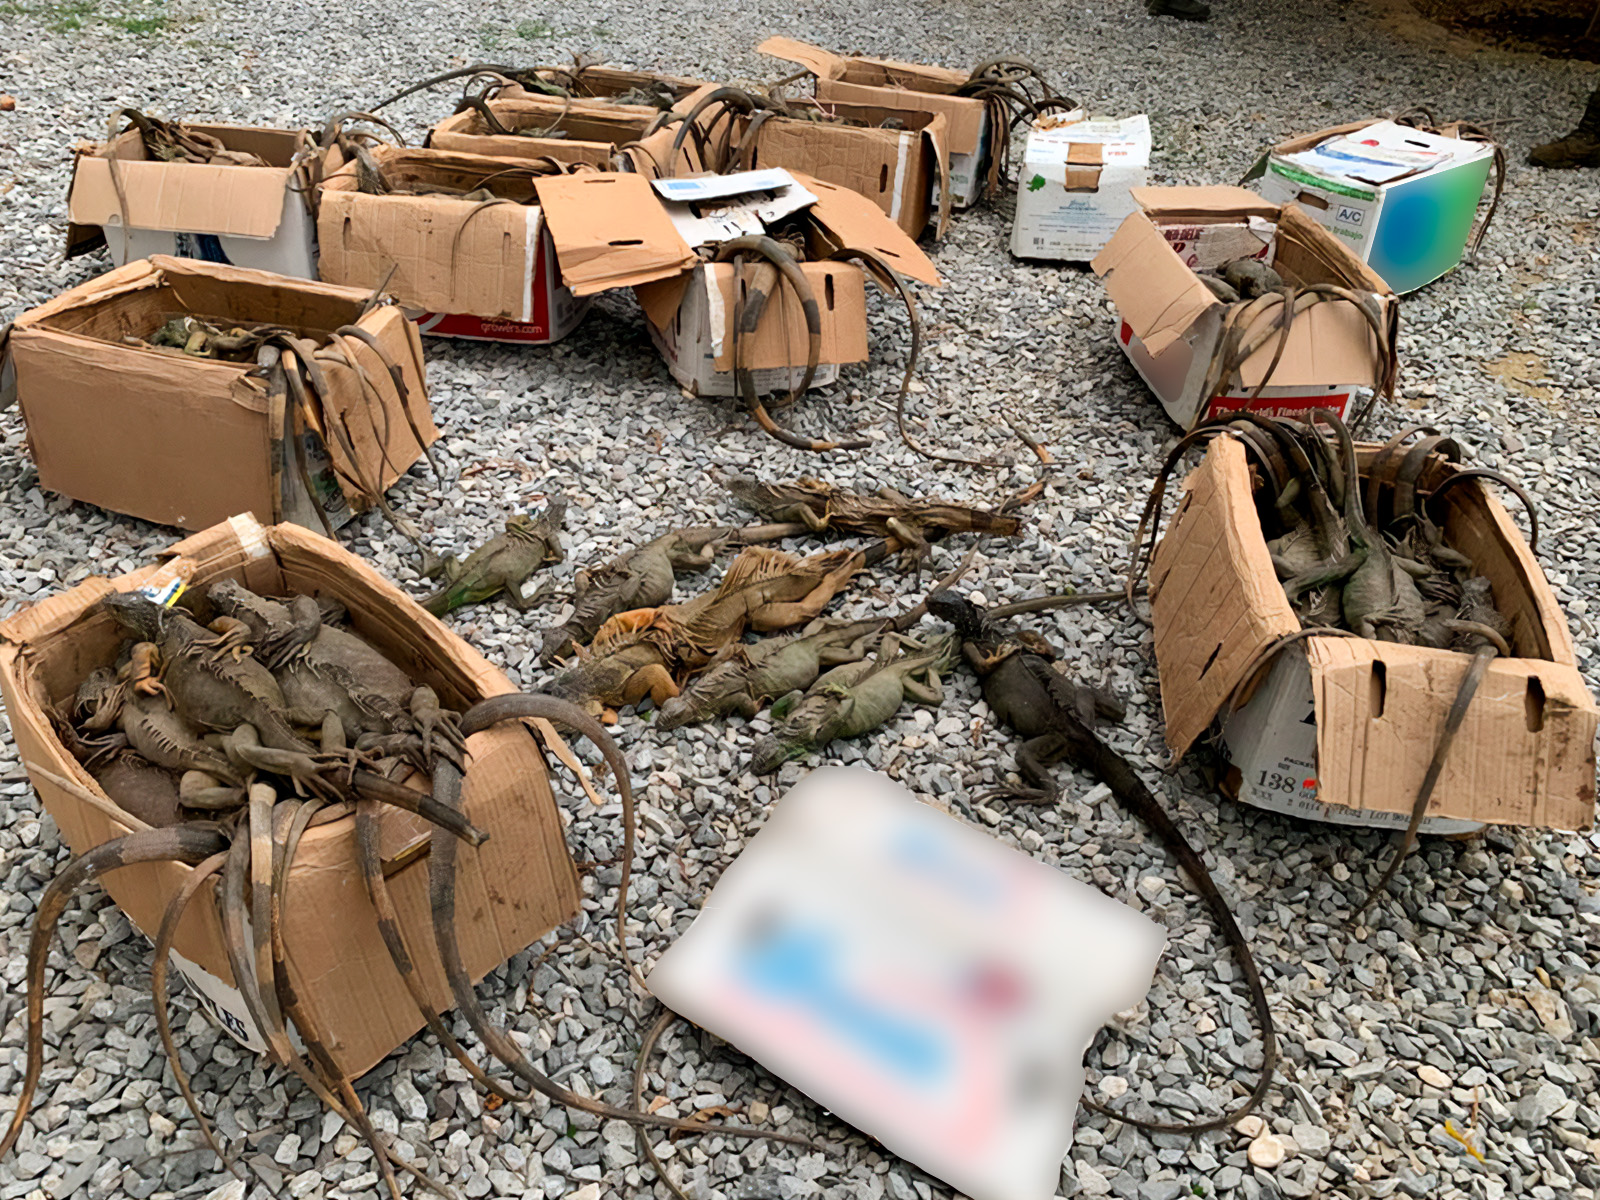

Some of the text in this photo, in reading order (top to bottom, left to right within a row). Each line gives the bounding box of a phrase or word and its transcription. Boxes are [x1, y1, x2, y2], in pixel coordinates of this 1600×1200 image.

[1339, 209, 1362, 222] A/C
[481, 322, 542, 333] growers.com
[1257, 770, 1297, 794] 138
